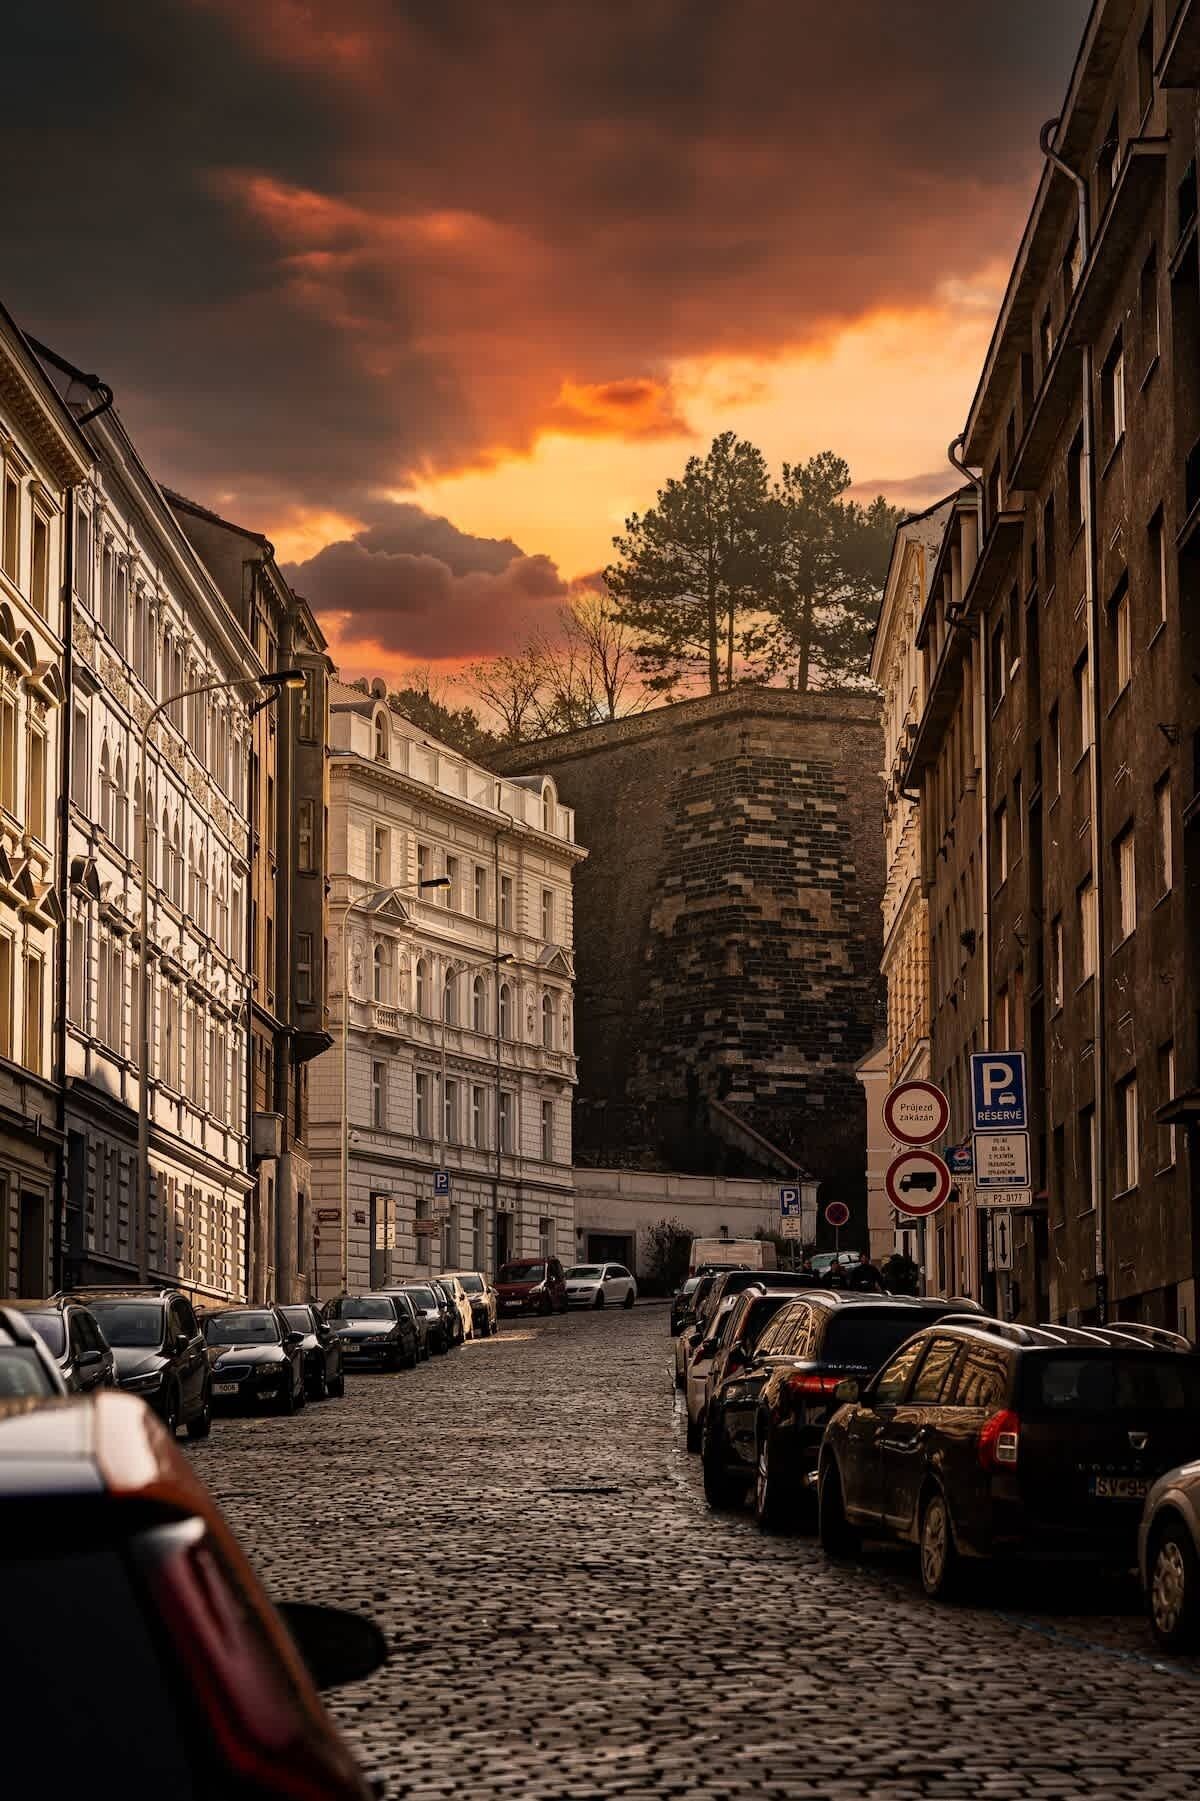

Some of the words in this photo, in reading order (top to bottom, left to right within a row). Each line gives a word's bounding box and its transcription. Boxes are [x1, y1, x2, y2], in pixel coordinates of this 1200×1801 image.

[982, 1062, 1014, 1106] P
[900, 1103, 933, 1113] Průjezd
[899, 1113, 934, 1121] zakázán
[783, 1190, 795, 1208] P
[993, 1193, 1023, 1203] P2-0177
